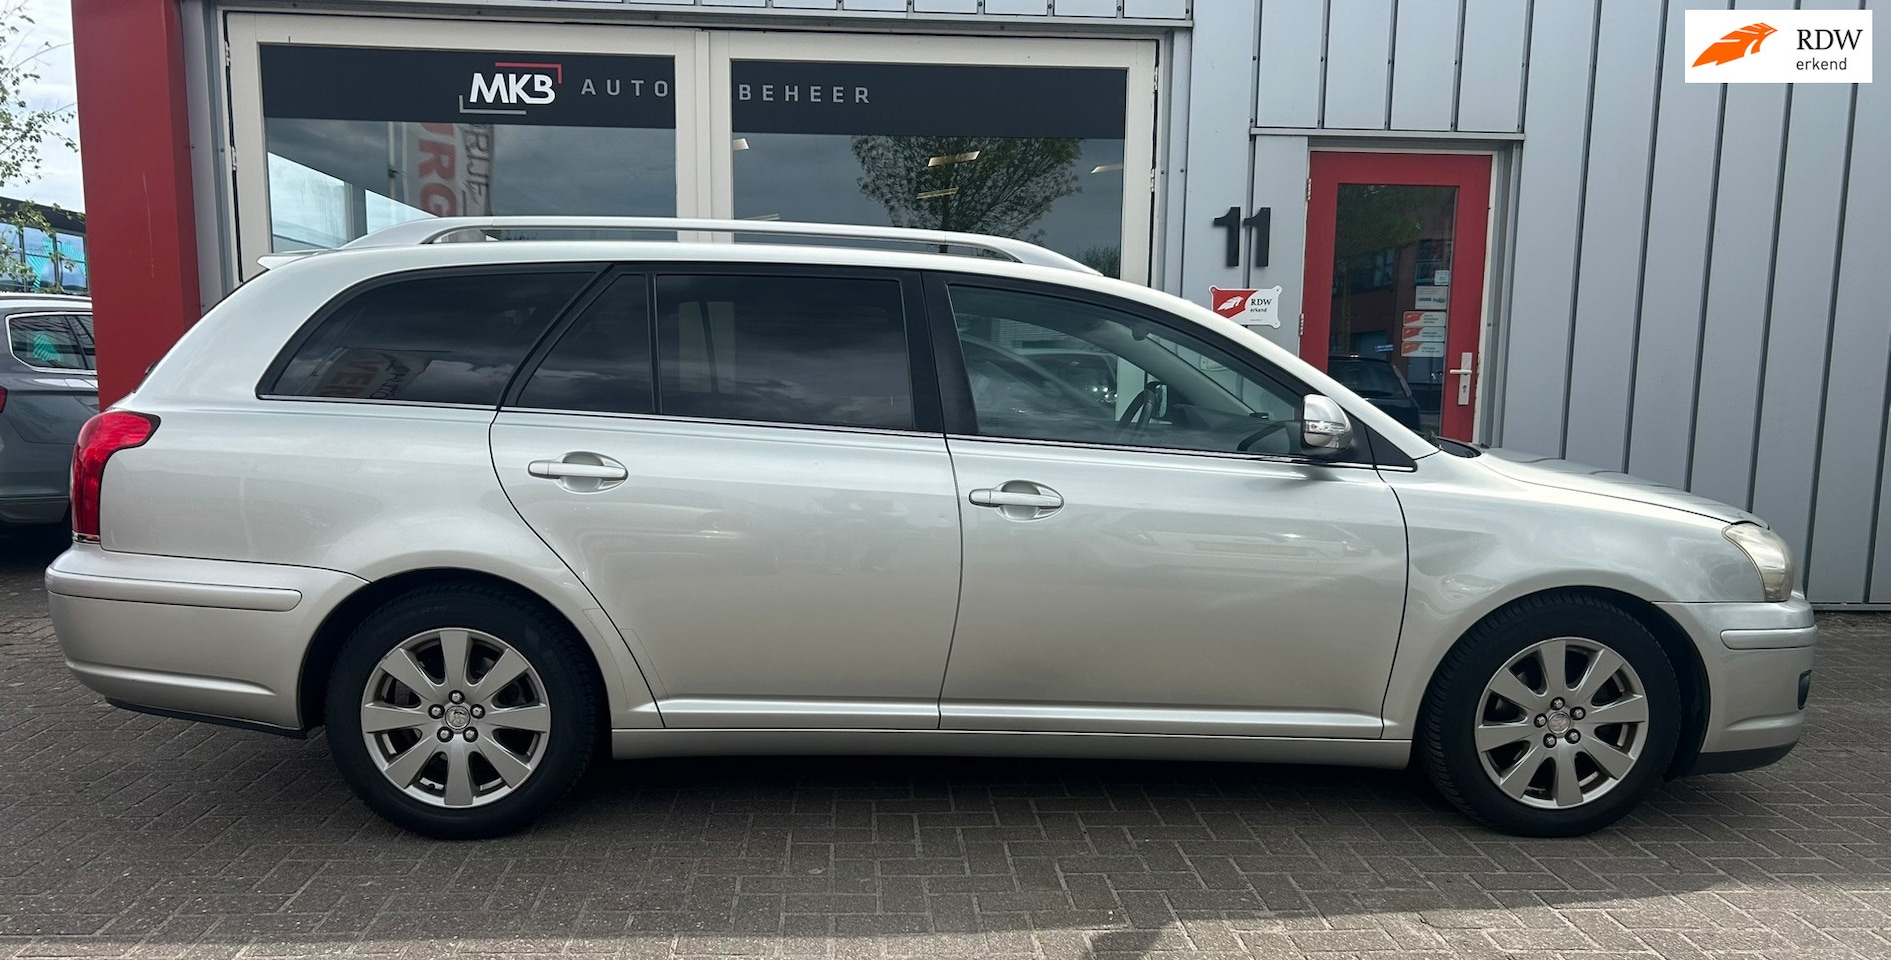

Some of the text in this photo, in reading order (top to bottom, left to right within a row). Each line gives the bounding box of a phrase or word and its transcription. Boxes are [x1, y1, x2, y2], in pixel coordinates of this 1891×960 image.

[469, 72, 870, 105] MKB AUTO BEHEER
[1212, 206, 1271, 267] 11
[1250, 298, 1273, 306] RDW
